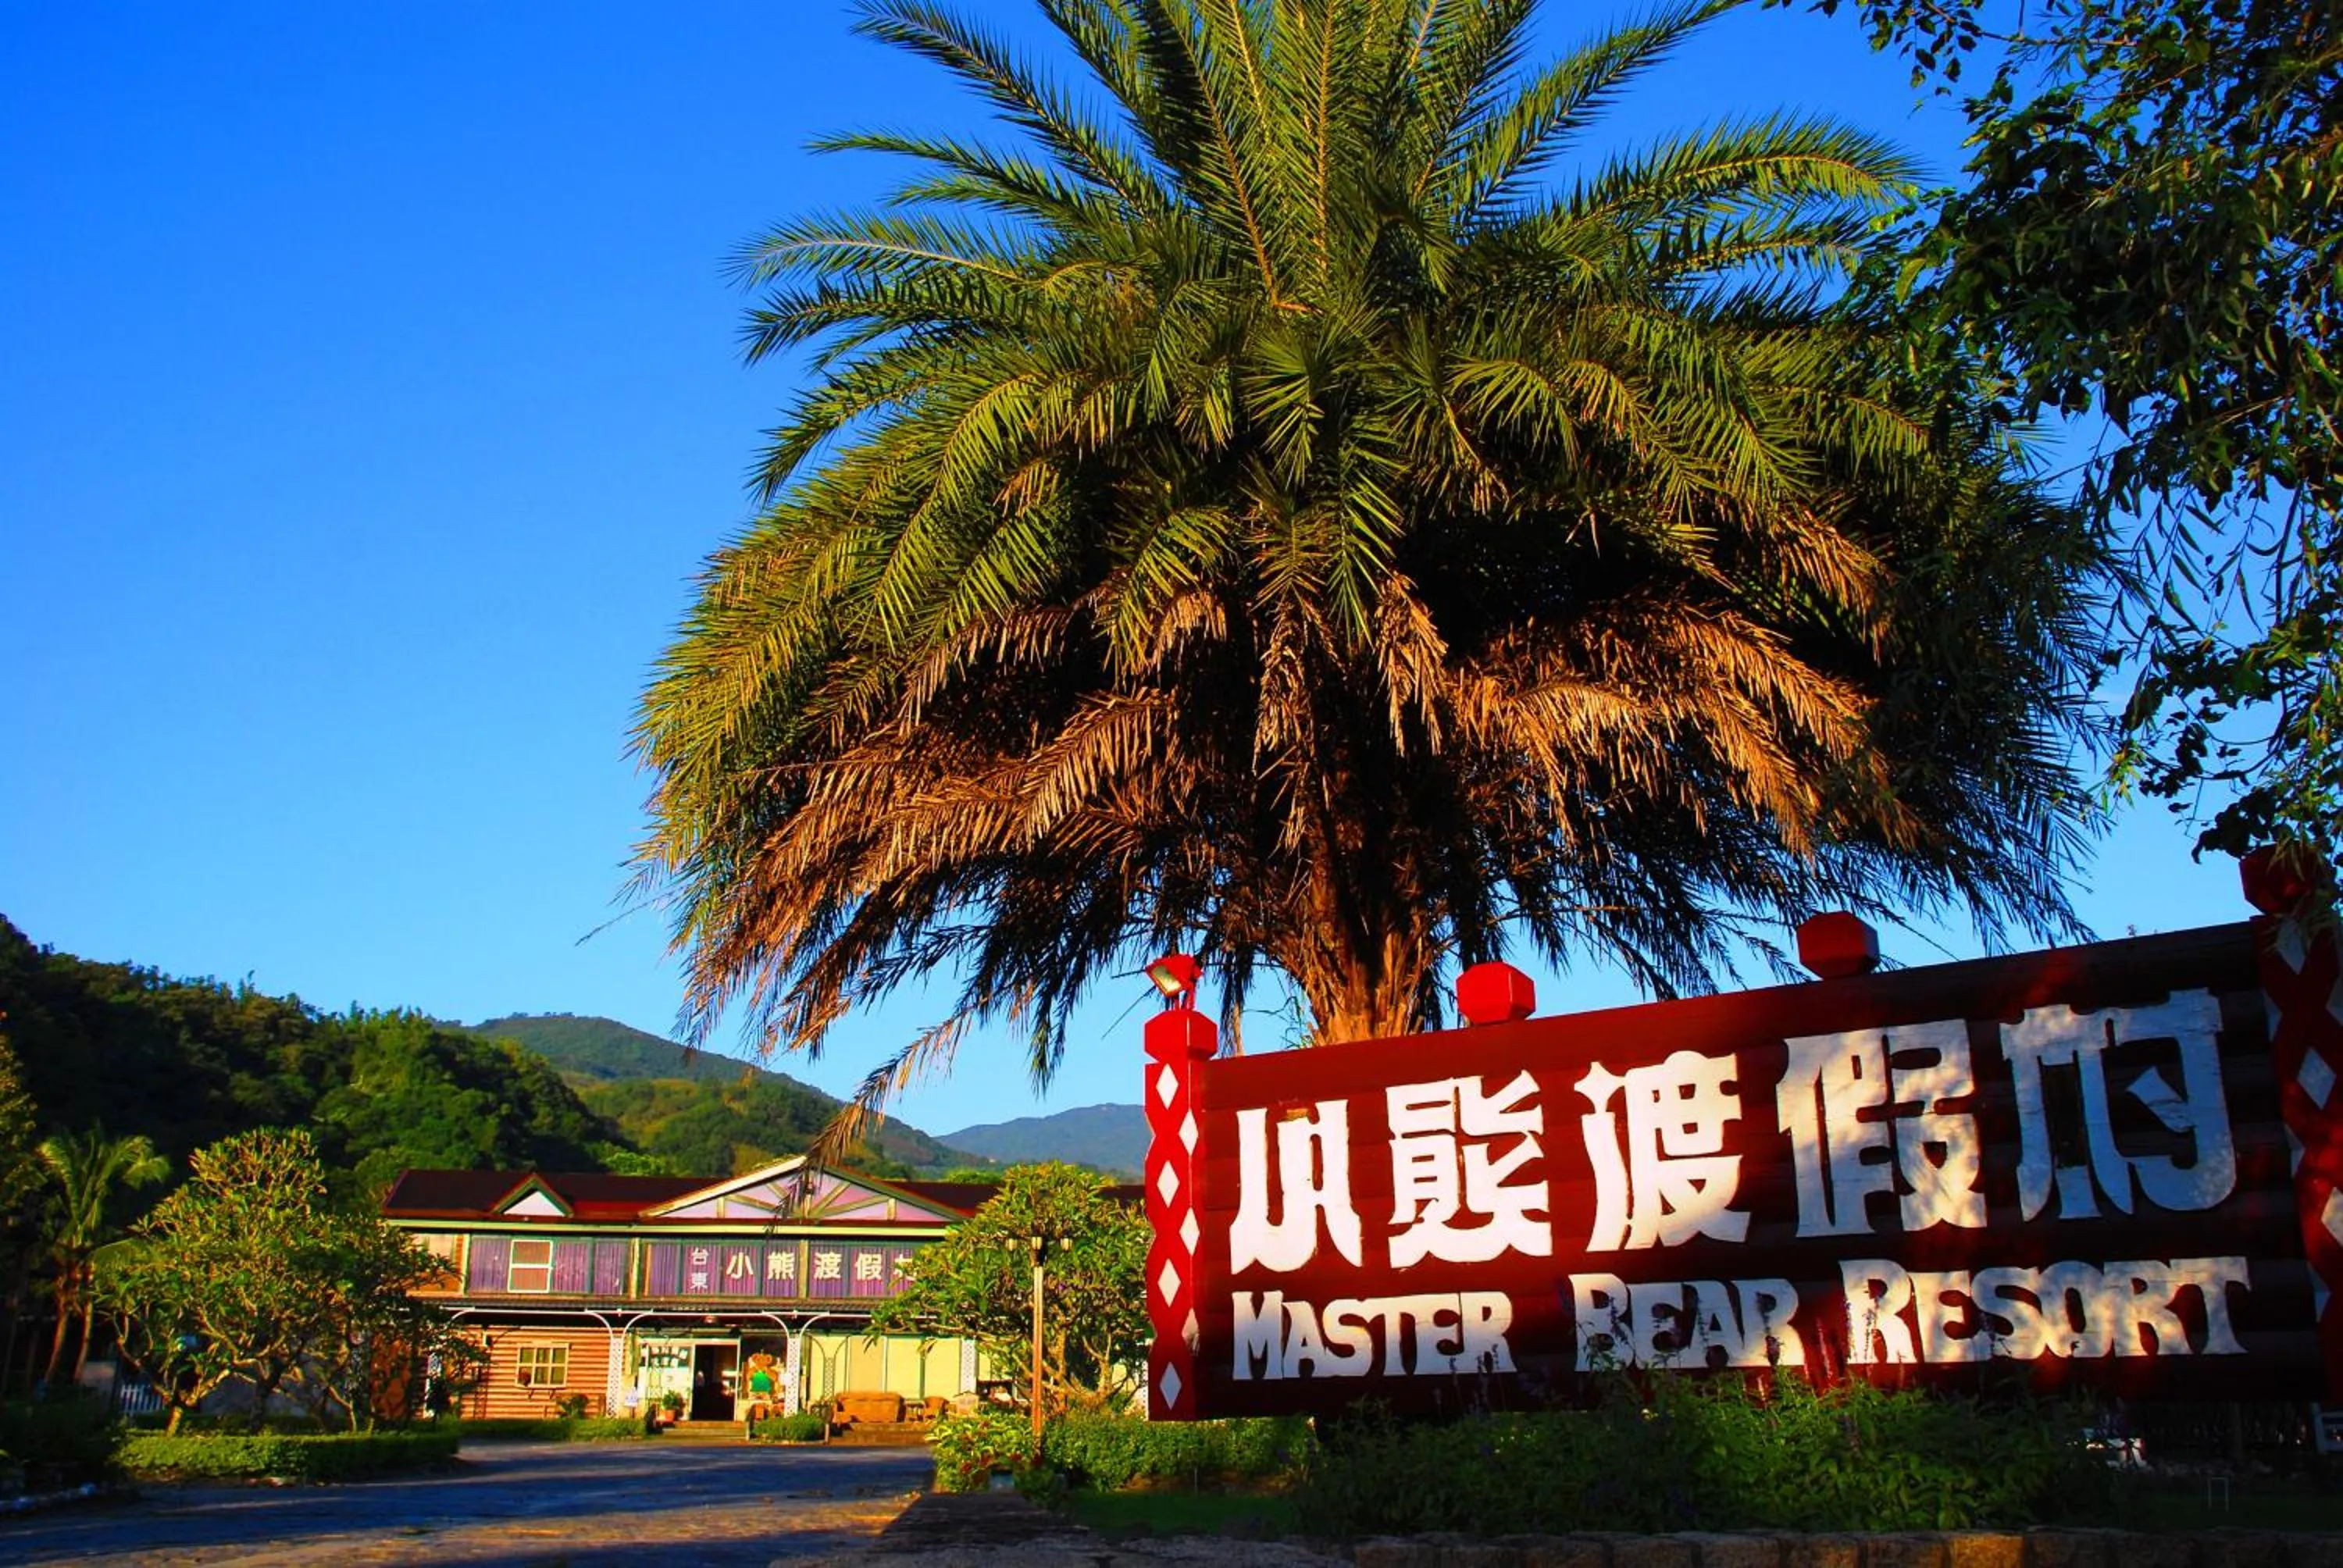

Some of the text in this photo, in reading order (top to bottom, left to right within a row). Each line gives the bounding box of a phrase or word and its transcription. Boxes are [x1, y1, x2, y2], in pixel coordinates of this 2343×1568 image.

[1229, 986, 2237, 1275] 小熊渡假村
[690, 1247, 709, 1290] 台東
[1232, 1256, 2252, 1381] MASTER BEAR RESORT
